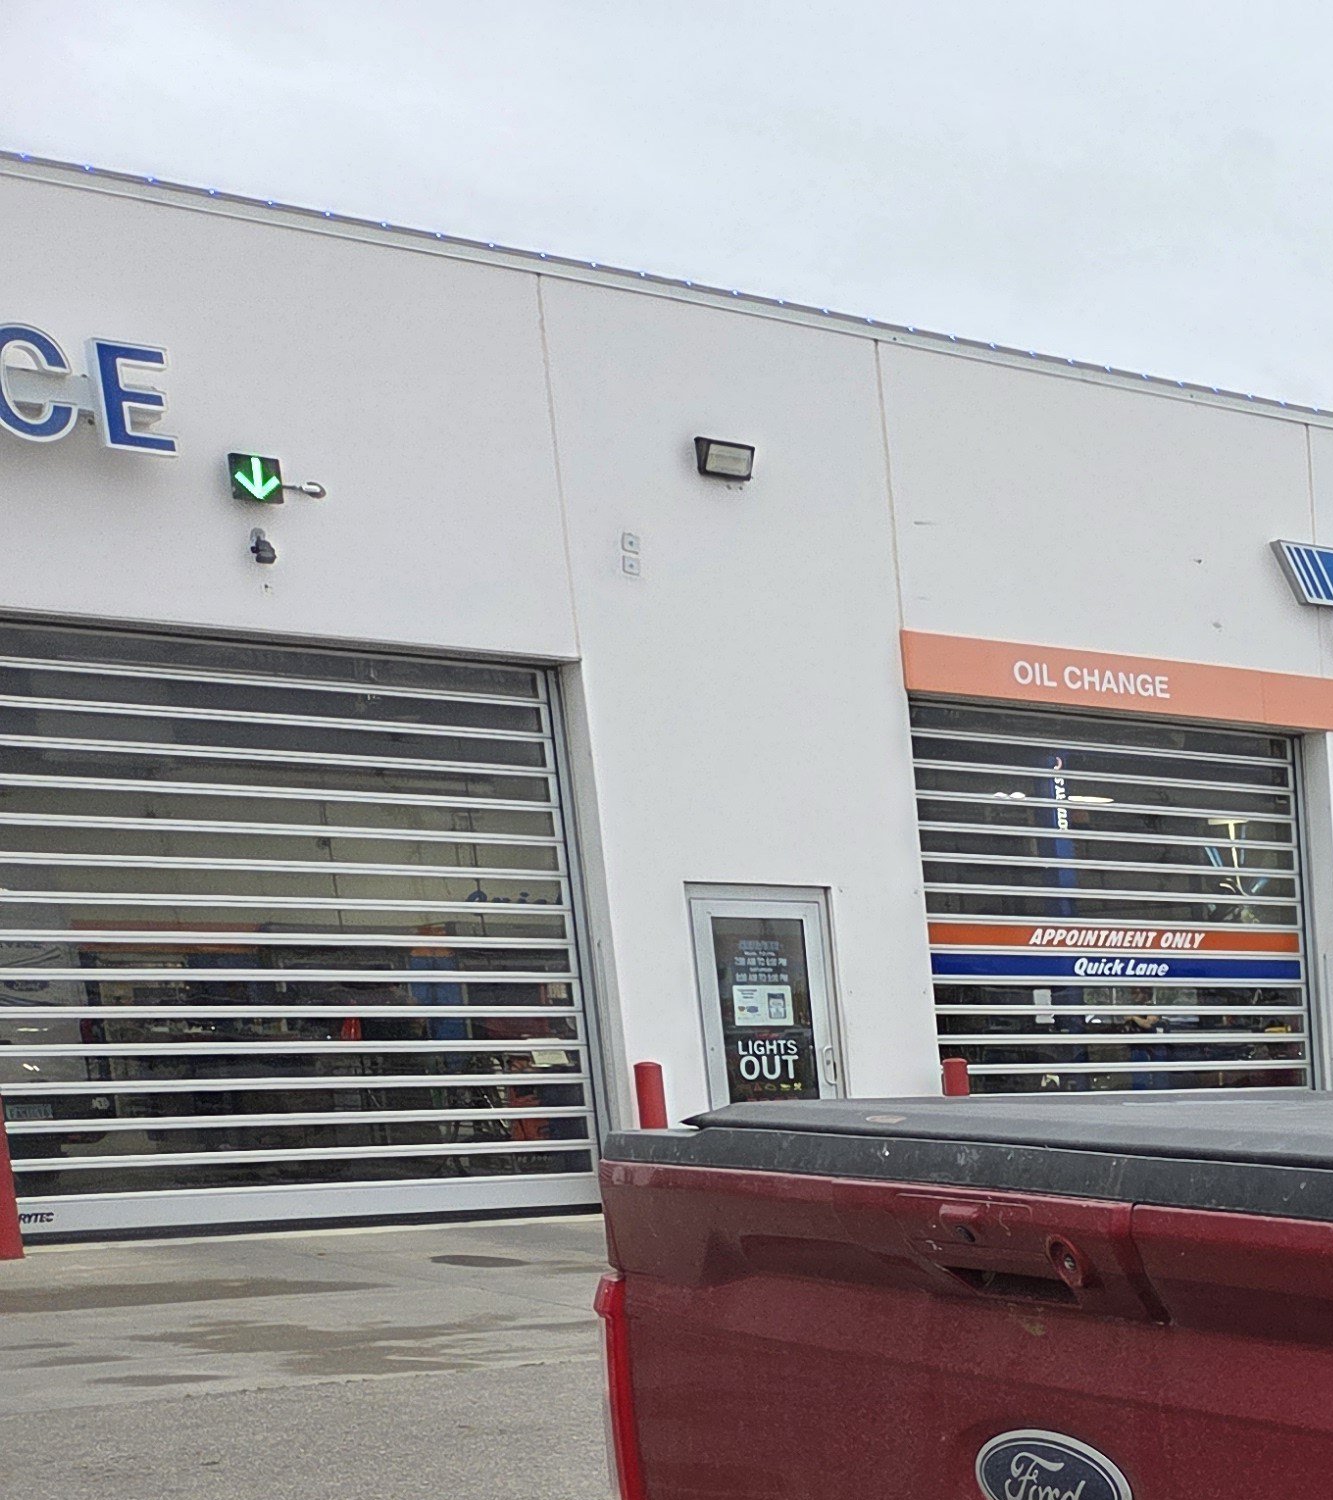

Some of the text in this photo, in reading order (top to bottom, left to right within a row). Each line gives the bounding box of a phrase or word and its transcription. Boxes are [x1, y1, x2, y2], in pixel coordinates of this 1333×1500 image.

[1013, 660, 1170, 698] OIL CHANGE
[1029, 928, 1206, 949] APPOINTMENT ONLY
[1074, 957, 1169, 976] Quick Lane
[737, 1040, 798, 1055] LIGHTS
[740, 1054, 799, 1080] OUT
[18, 1212, 55, 1224] RYTEC
